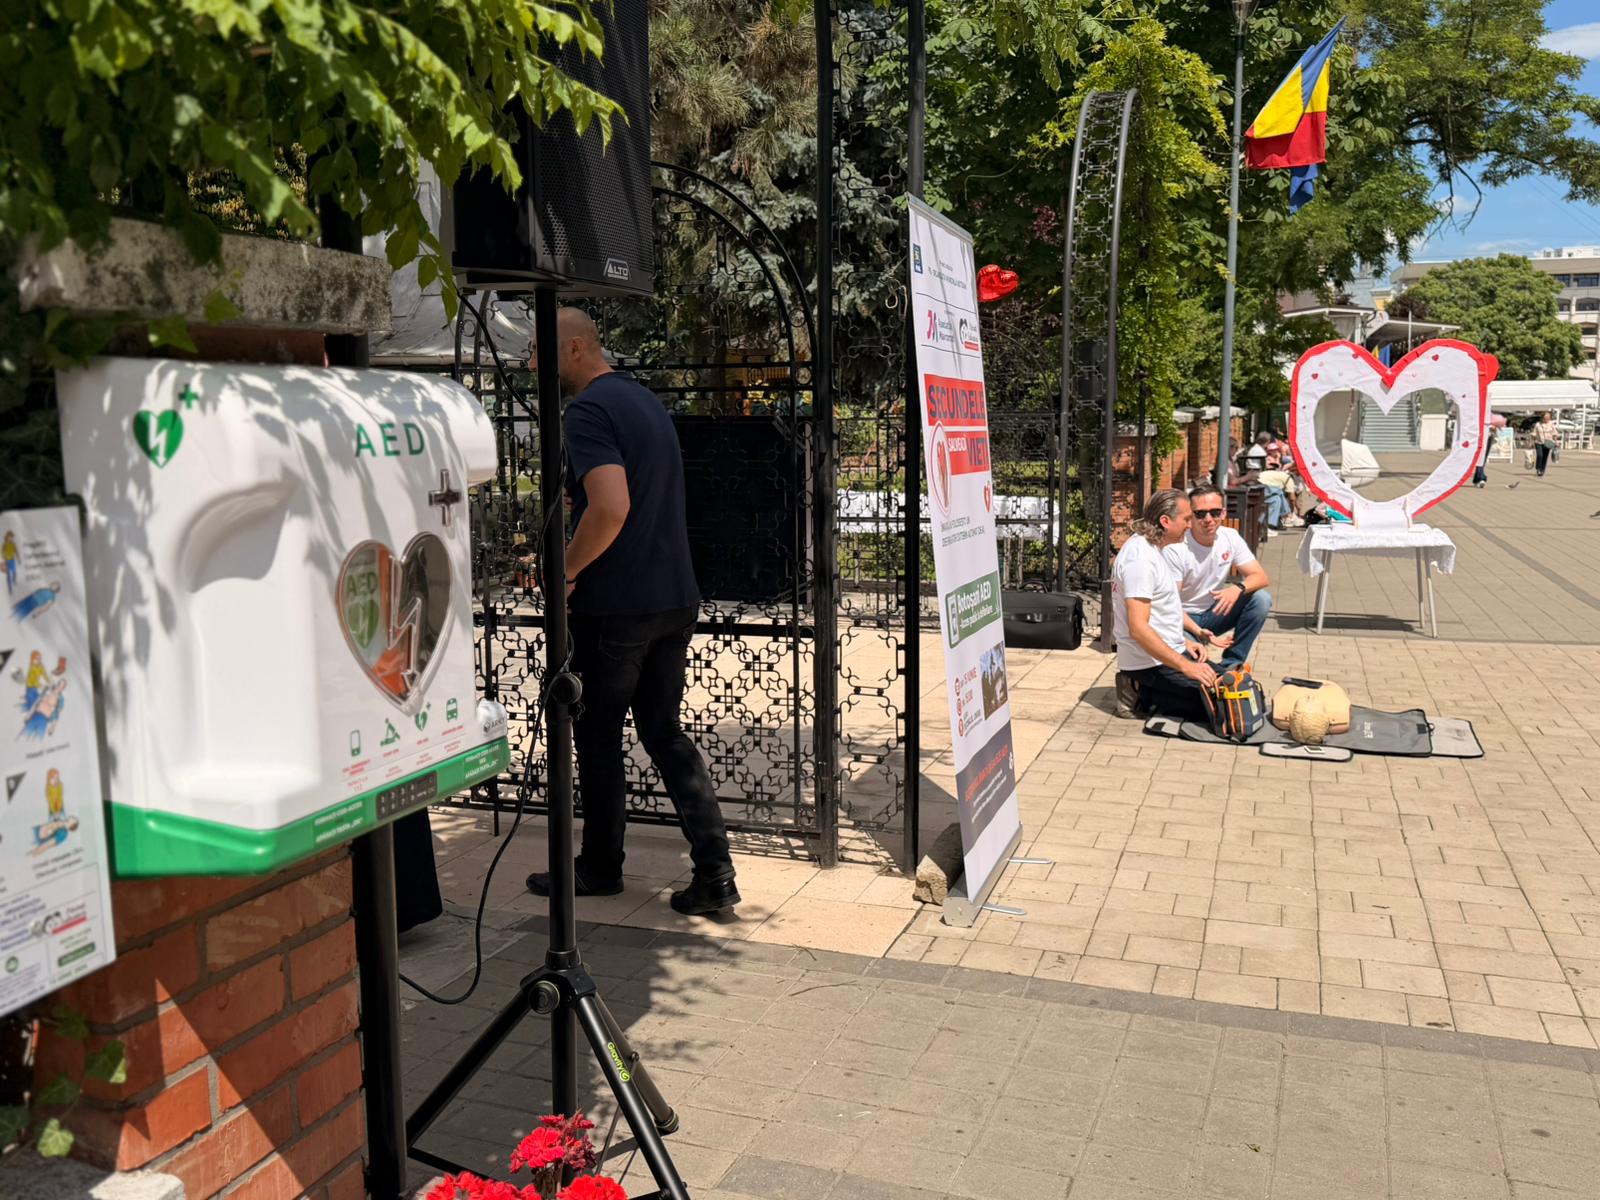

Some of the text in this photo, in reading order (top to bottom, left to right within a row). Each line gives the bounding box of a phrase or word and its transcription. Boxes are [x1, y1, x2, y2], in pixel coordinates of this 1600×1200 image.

[607, 263, 628, 277] ALTO
[928, 385, 985, 419] SECUNDELE
[355, 423, 425, 458] AED
[346, 572, 378, 597] AED
